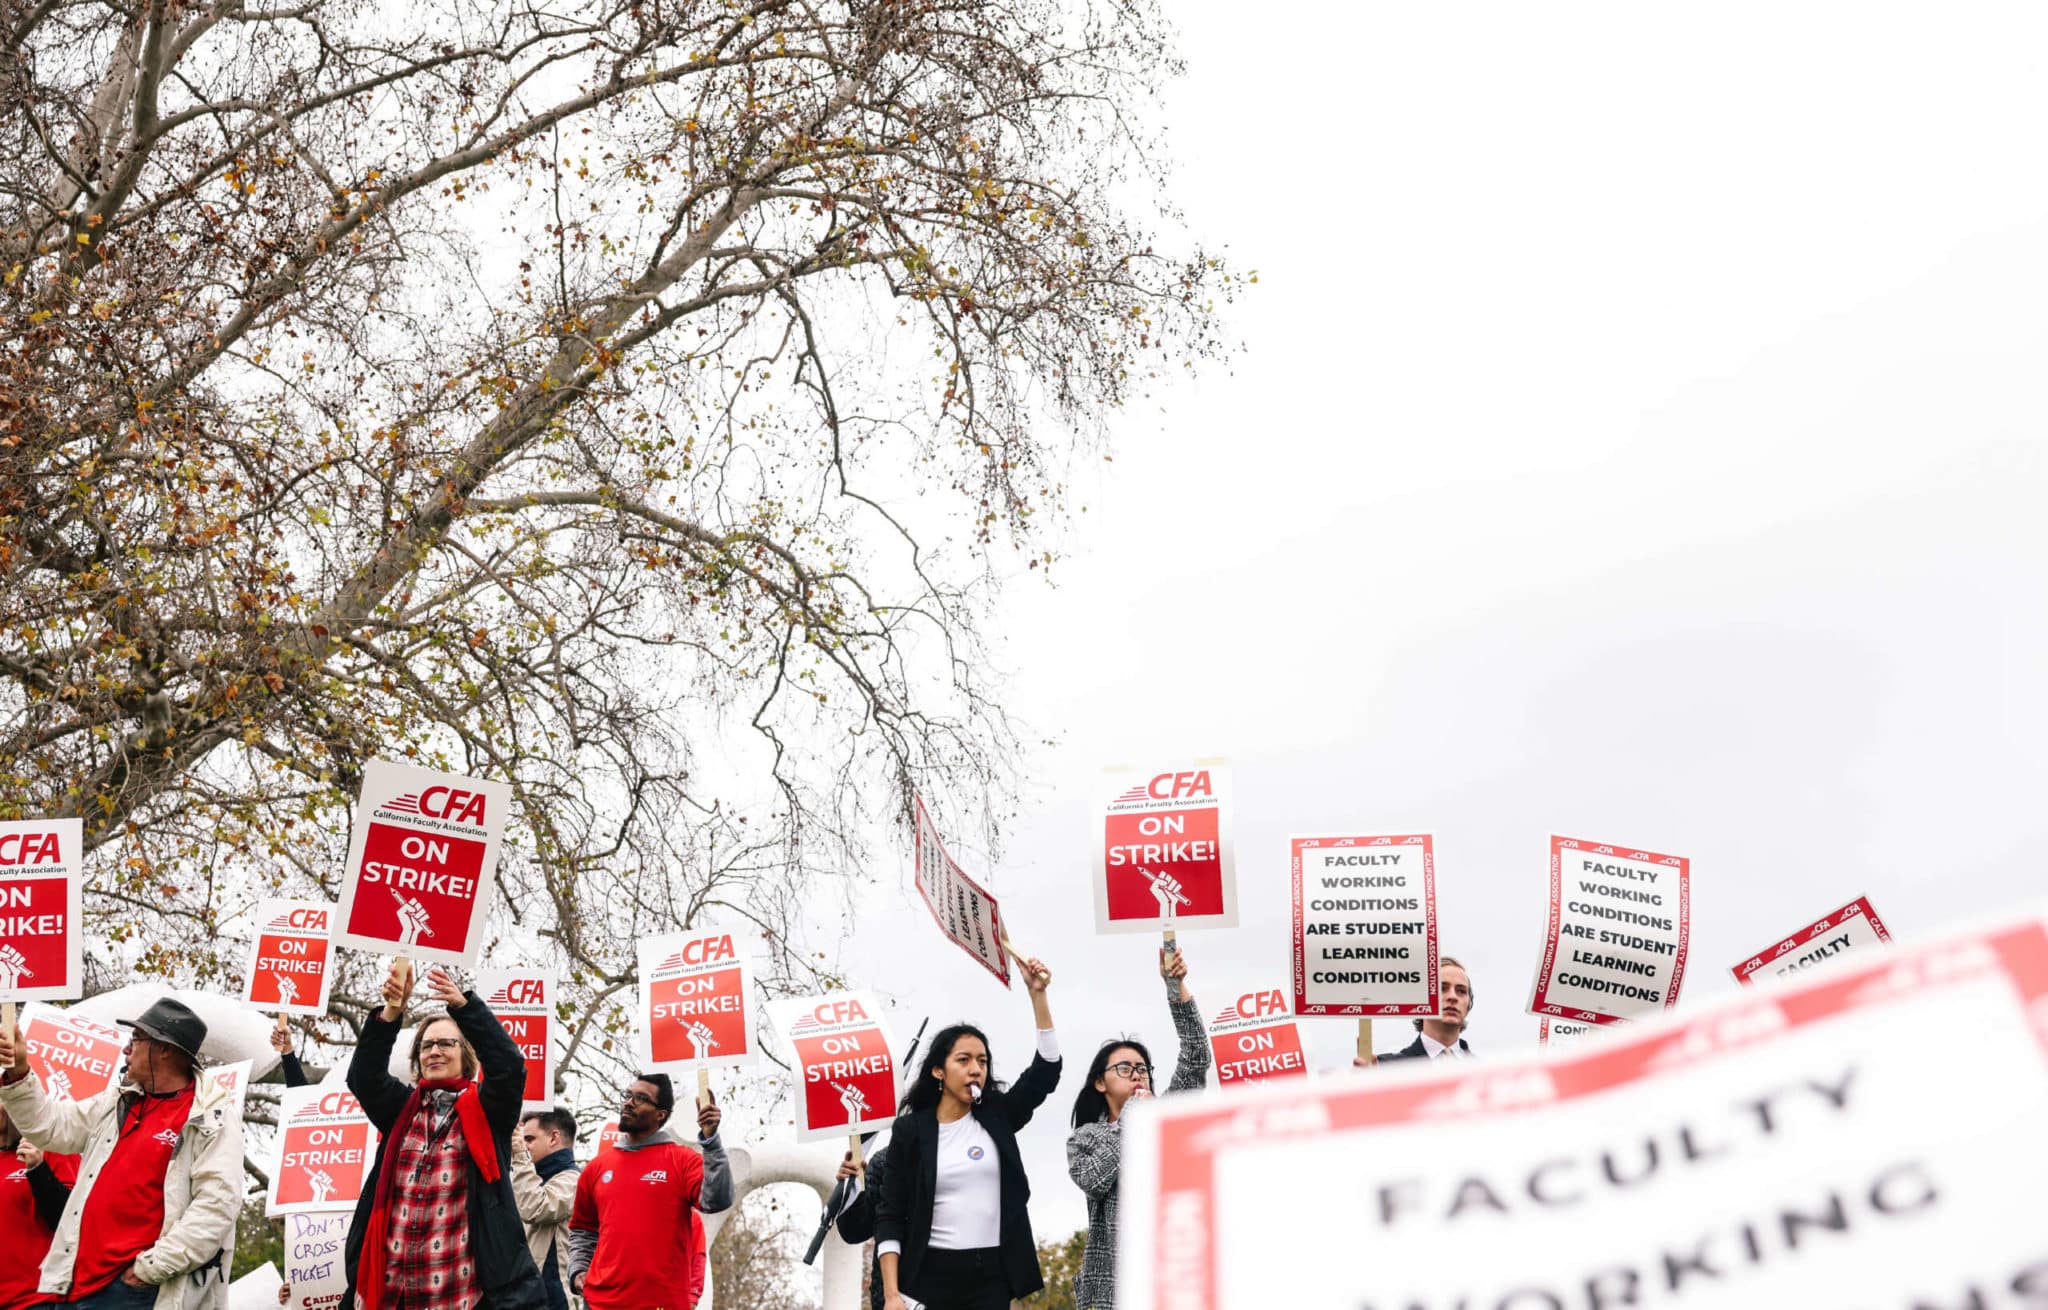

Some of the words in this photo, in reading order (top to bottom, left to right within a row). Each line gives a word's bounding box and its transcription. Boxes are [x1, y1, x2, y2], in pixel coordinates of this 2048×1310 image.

[1148, 770, 1212, 800] CFA
[419, 785, 486, 826] CFA
[1107, 803, 1144, 811] California
[1145, 801, 1172, 809] Faculty
[1174, 798, 1218, 806] Association
[373, 810, 412, 823] California
[413, 818, 441, 830] Faculty
[443, 823, 488, 837] Association
[1138, 815, 1185, 836] ON
[401, 836, 450, 865] ON
[1109, 840, 1216, 866] STRIKE!
[1324, 855, 1401, 867] FACULTY
[1563, 840, 1579, 848] CFA
[1599, 846, 1614, 855] CFA
[1634, 852, 1650, 861] CFA
[1665, 857, 1681, 867] CFA
[21, 866, 67, 874] Association
[363, 861, 474, 899] STRIKE!
[1321, 876, 1406, 888] WORKING
[1583, 860, 1658, 883] FACULTY
[1310, 898, 1418, 911] CONDITIONS
[1579, 881, 1663, 906] WORKING
[289, 908, 328, 930] CFA
[1294, 907, 1302, 944] FACULTY
[1306, 923, 1340, 935] ARE
[1345, 922, 1424, 935] STUDENT
[1426, 900, 1435, 937] FACULTY
[1568, 901, 1673, 931] CONDITIONS
[279, 940, 308, 955] ON
[1538, 943, 1554, 993] CALIFORNIA
[1549, 904, 1559, 942] FACULTY
[1561, 923, 1595, 940] ARE
[1599, 930, 1676, 956] STUDENT
[1678, 924, 1688, 962] FACULTY
[1746, 957, 1764, 971] CFA
[1779, 938, 1797, 952] CFA
[1814, 920, 1831, 933] CFA
[1844, 903, 1861, 917] CFA
[682, 934, 735, 966] CFA
[1322, 947, 1409, 960] LEARNING
[258, 957, 322, 974] STRIKE!
[1295, 946, 1303, 995] CALIFORNIA
[1428, 939, 1437, 995] ASSOCIATION
[1572, 950, 1657, 978] LEARNING
[677, 976, 715, 996] ON
[1313, 971, 1421, 984] CONDITIONS
[1558, 972, 1660, 1003] CONDITIONS
[507, 979, 544, 1005] CFA
[1236, 989, 1288, 1019] CFA
[653, 995, 740, 1018] STRIKE!
[814, 999, 869, 1025] CFA
[1310, 1005, 1327, 1013] CFA
[1346, 1005, 1362, 1013] CFA
[1383, 1005, 1400, 1013] CFA
[1415, 1005, 1432, 1013] CFA
[1548, 1005, 1562, 1015] CFA
[1582, 1012, 1596, 1022] CFA
[56, 1030, 94, 1051] ON
[1209, 1024, 1238, 1032] California
[822, 1035, 861, 1055] ON
[1238, 1032, 1274, 1053] ON
[26, 1039, 112, 1078] STRIKE!
[806, 1054, 889, 1083] STRIKE!
[1219, 1050, 1302, 1080] STRIKE!
[308, 1129, 343, 1145] ON
[1376, 1065, 1859, 1226] FACULTY
[284, 1149, 363, 1168] STRIKE!
[651, 1170, 667, 1180] CFA
[291, 1213, 350, 1239] DON'T
[294, 1240, 338, 1260] CROSS
[291, 1261, 334, 1284] PICKET
